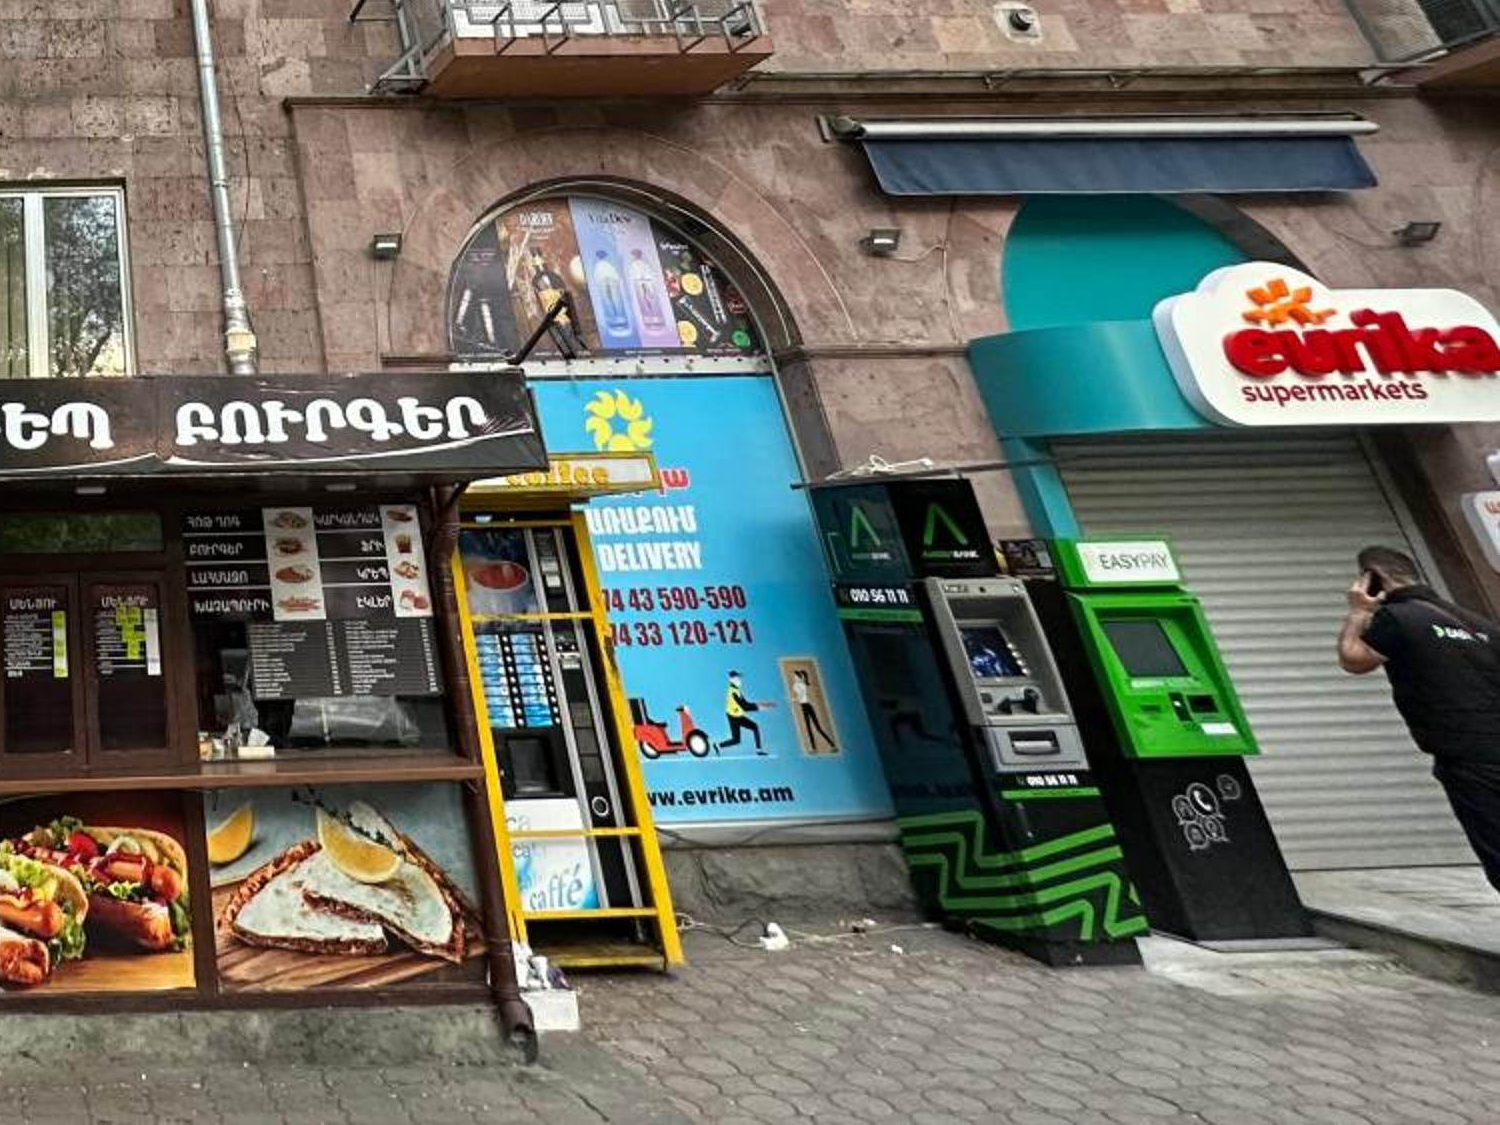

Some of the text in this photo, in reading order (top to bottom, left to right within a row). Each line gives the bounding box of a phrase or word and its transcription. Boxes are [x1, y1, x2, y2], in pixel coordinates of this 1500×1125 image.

[1242, 380, 1428, 407] supermarkets
[176, 395, 490, 446] ԲՈՒՐԳԵՐ
[597, 541, 703, 572] DELIVERY
[1099, 554, 1167, 570] EASYPAY
[628, 587, 654, 612] 43
[657, 585, 747, 611] 590-590
[634, 622, 663, 646] 33
[668, 619, 753, 646] 120-121
